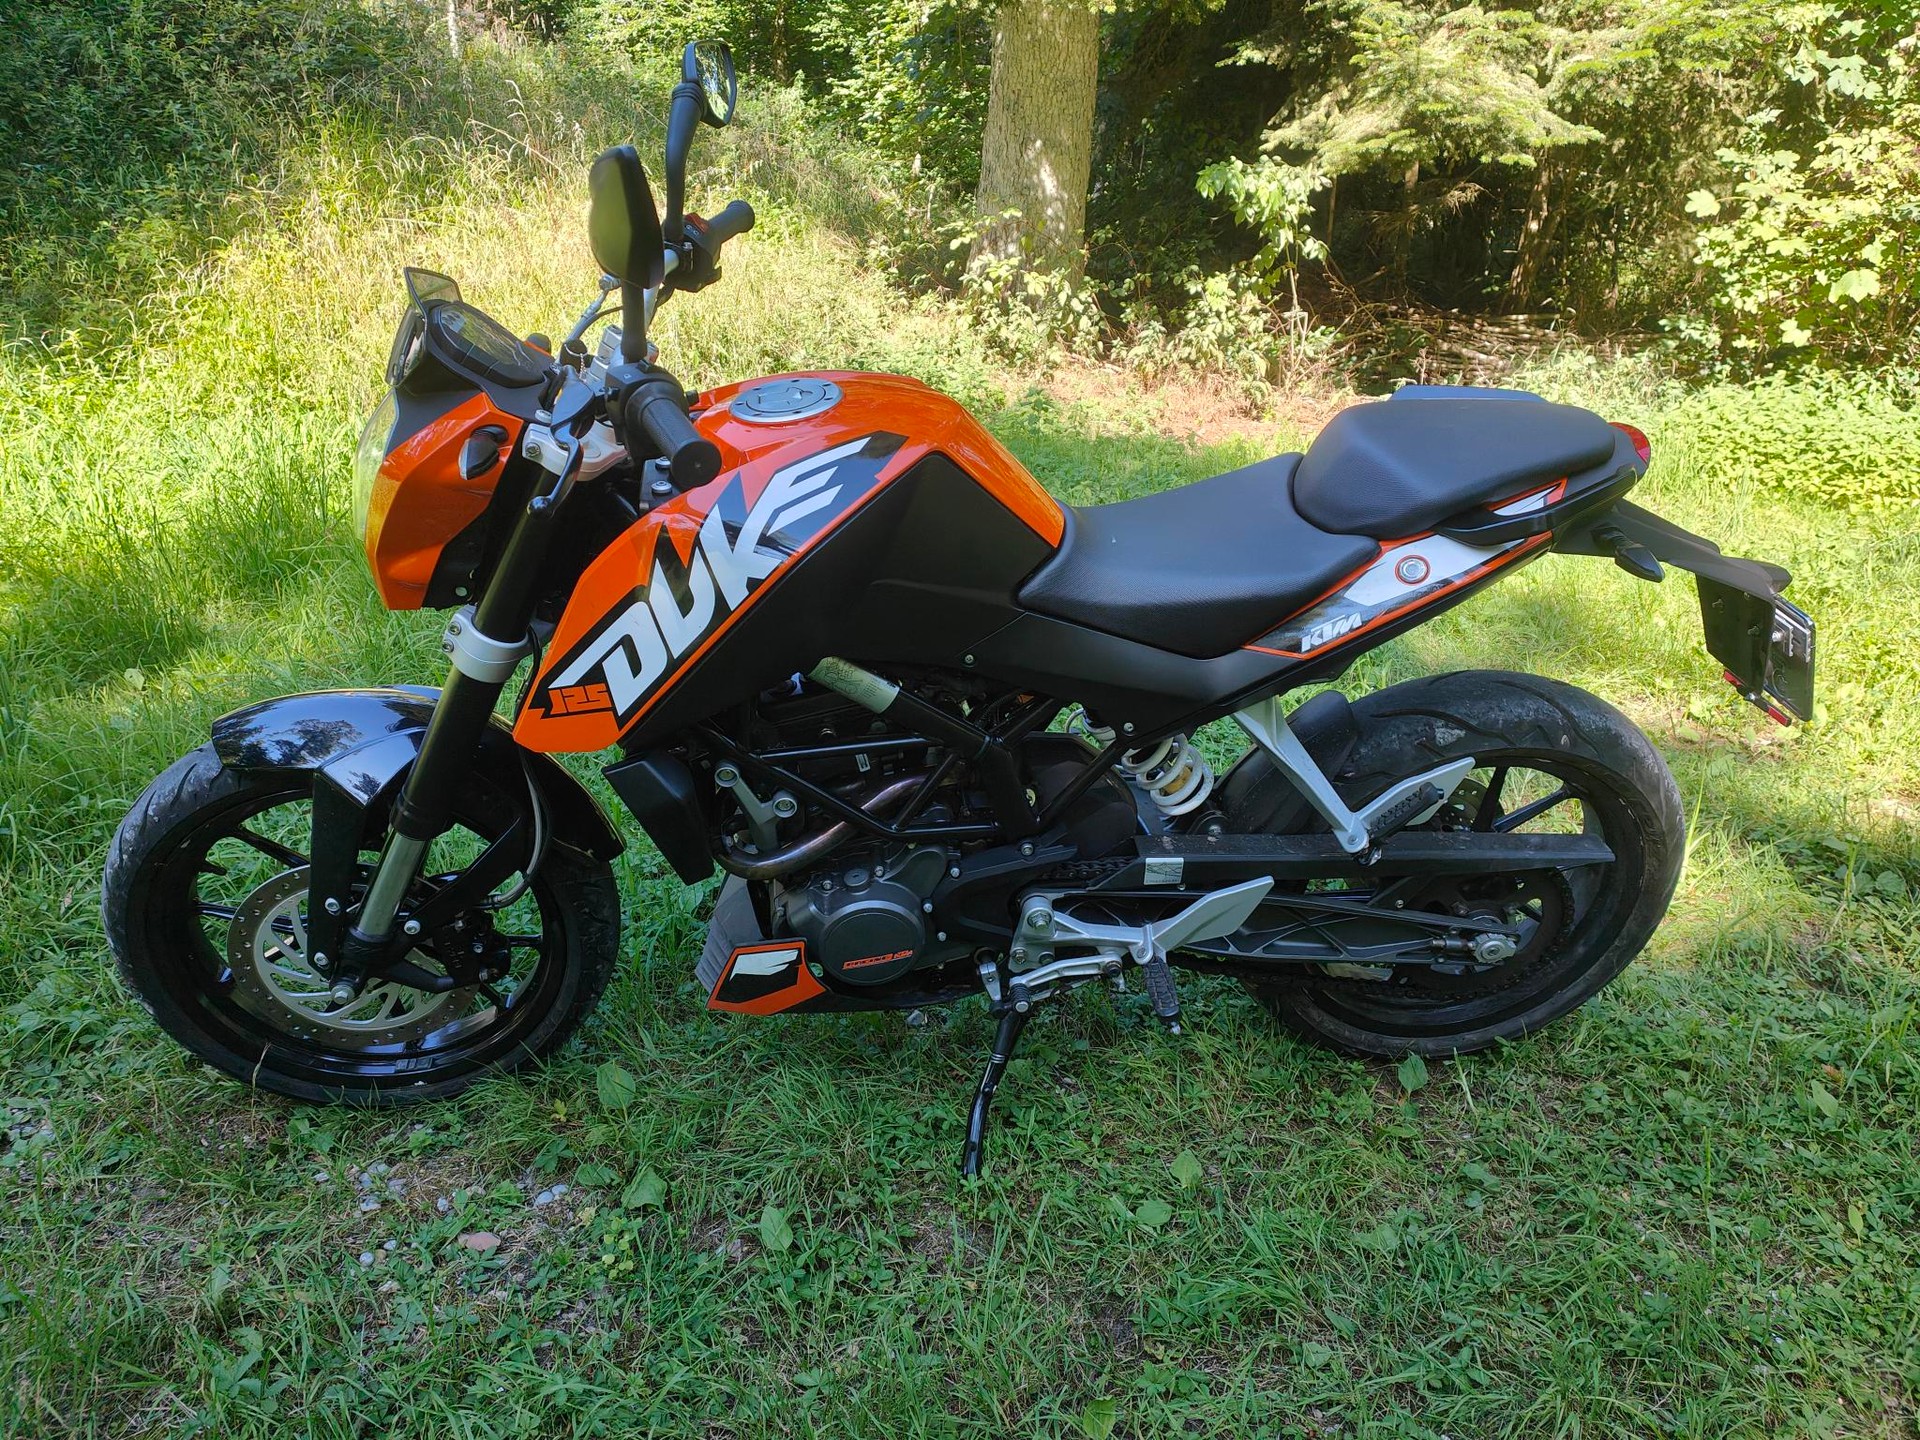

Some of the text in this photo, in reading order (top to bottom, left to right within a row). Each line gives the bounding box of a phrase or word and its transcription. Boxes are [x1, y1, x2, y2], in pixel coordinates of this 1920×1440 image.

[547, 437, 872, 717] DUKE
[1301, 612, 1363, 653] KTM
[548, 683, 612, 715] 125
